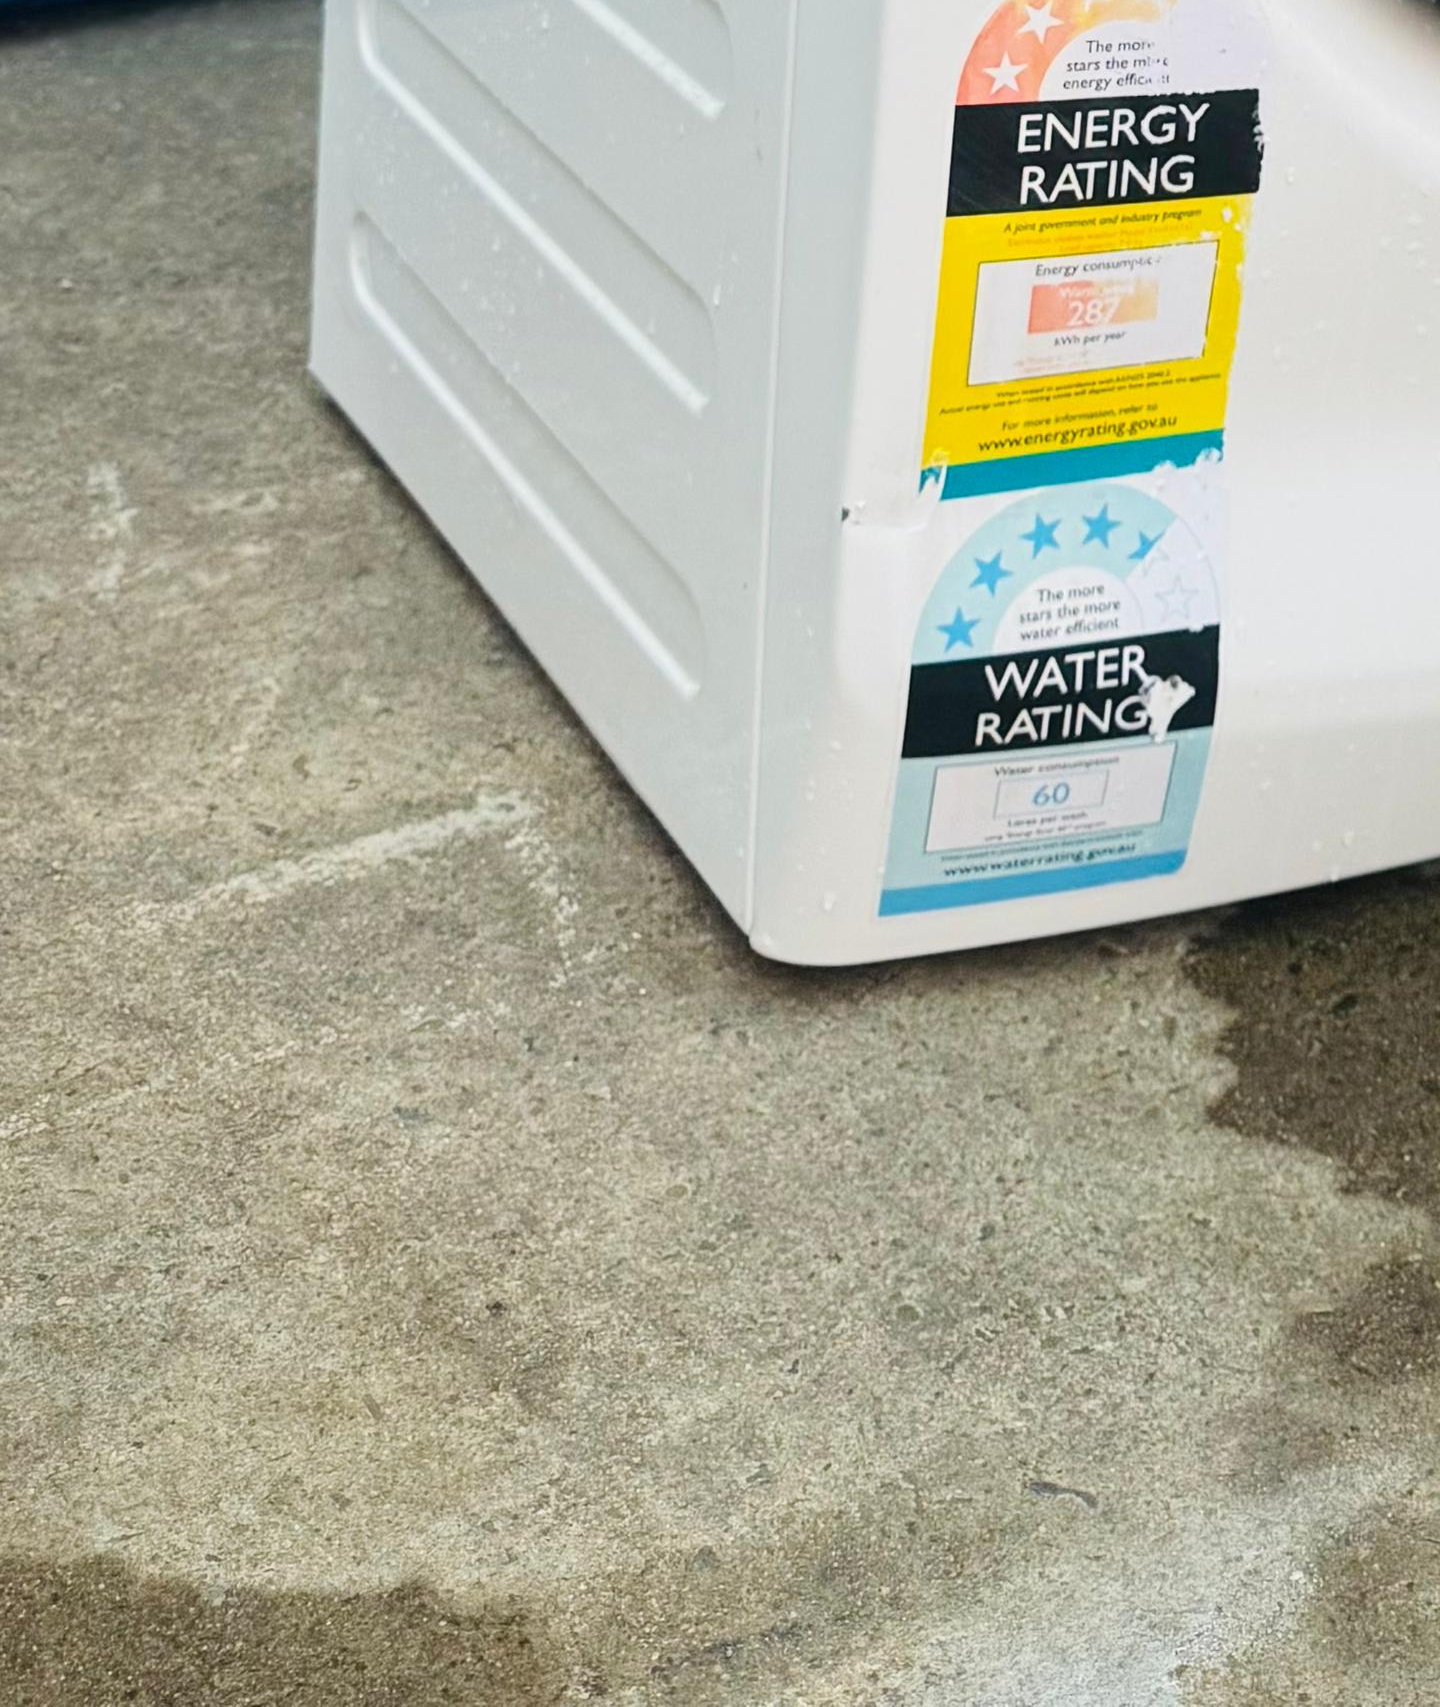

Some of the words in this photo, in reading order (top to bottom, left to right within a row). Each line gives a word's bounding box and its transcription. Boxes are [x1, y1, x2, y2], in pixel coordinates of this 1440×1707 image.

[1086, 39, 1113, 54] The
[1066, 60, 1101, 73] stars
[1105, 56, 1129, 70] the
[1062, 76, 1112, 92] energy
[1017, 102, 1211, 154] ENERGY
[1019, 154, 1196, 206] RATING
[1003, 223, 1013, 233] A
[1013, 221, 1036, 235] joint
[1038, 217, 1097, 233] government
[1098, 214, 1120, 227] and
[1121, 210, 1159, 225] industry
[1034, 263, 1080, 278] Energy
[1066, 296, 1121, 328] 287
[978, 416, 1178, 451] www.energyrating.gov.au
[1037, 588, 1064, 603] The
[1067, 584, 1105, 599] more
[1019, 609, 1052, 625] stars
[1057, 602, 1080, 620] the
[1083, 599, 1121, 615] more
[1020, 624, 1061, 641] water
[1065, 617, 1119, 636] efficient
[984, 644, 1151, 702] WATER
[974, 694, 1150, 747] RATING
[994, 764, 1035, 777] Water
[1032, 782, 1071, 807] 60
